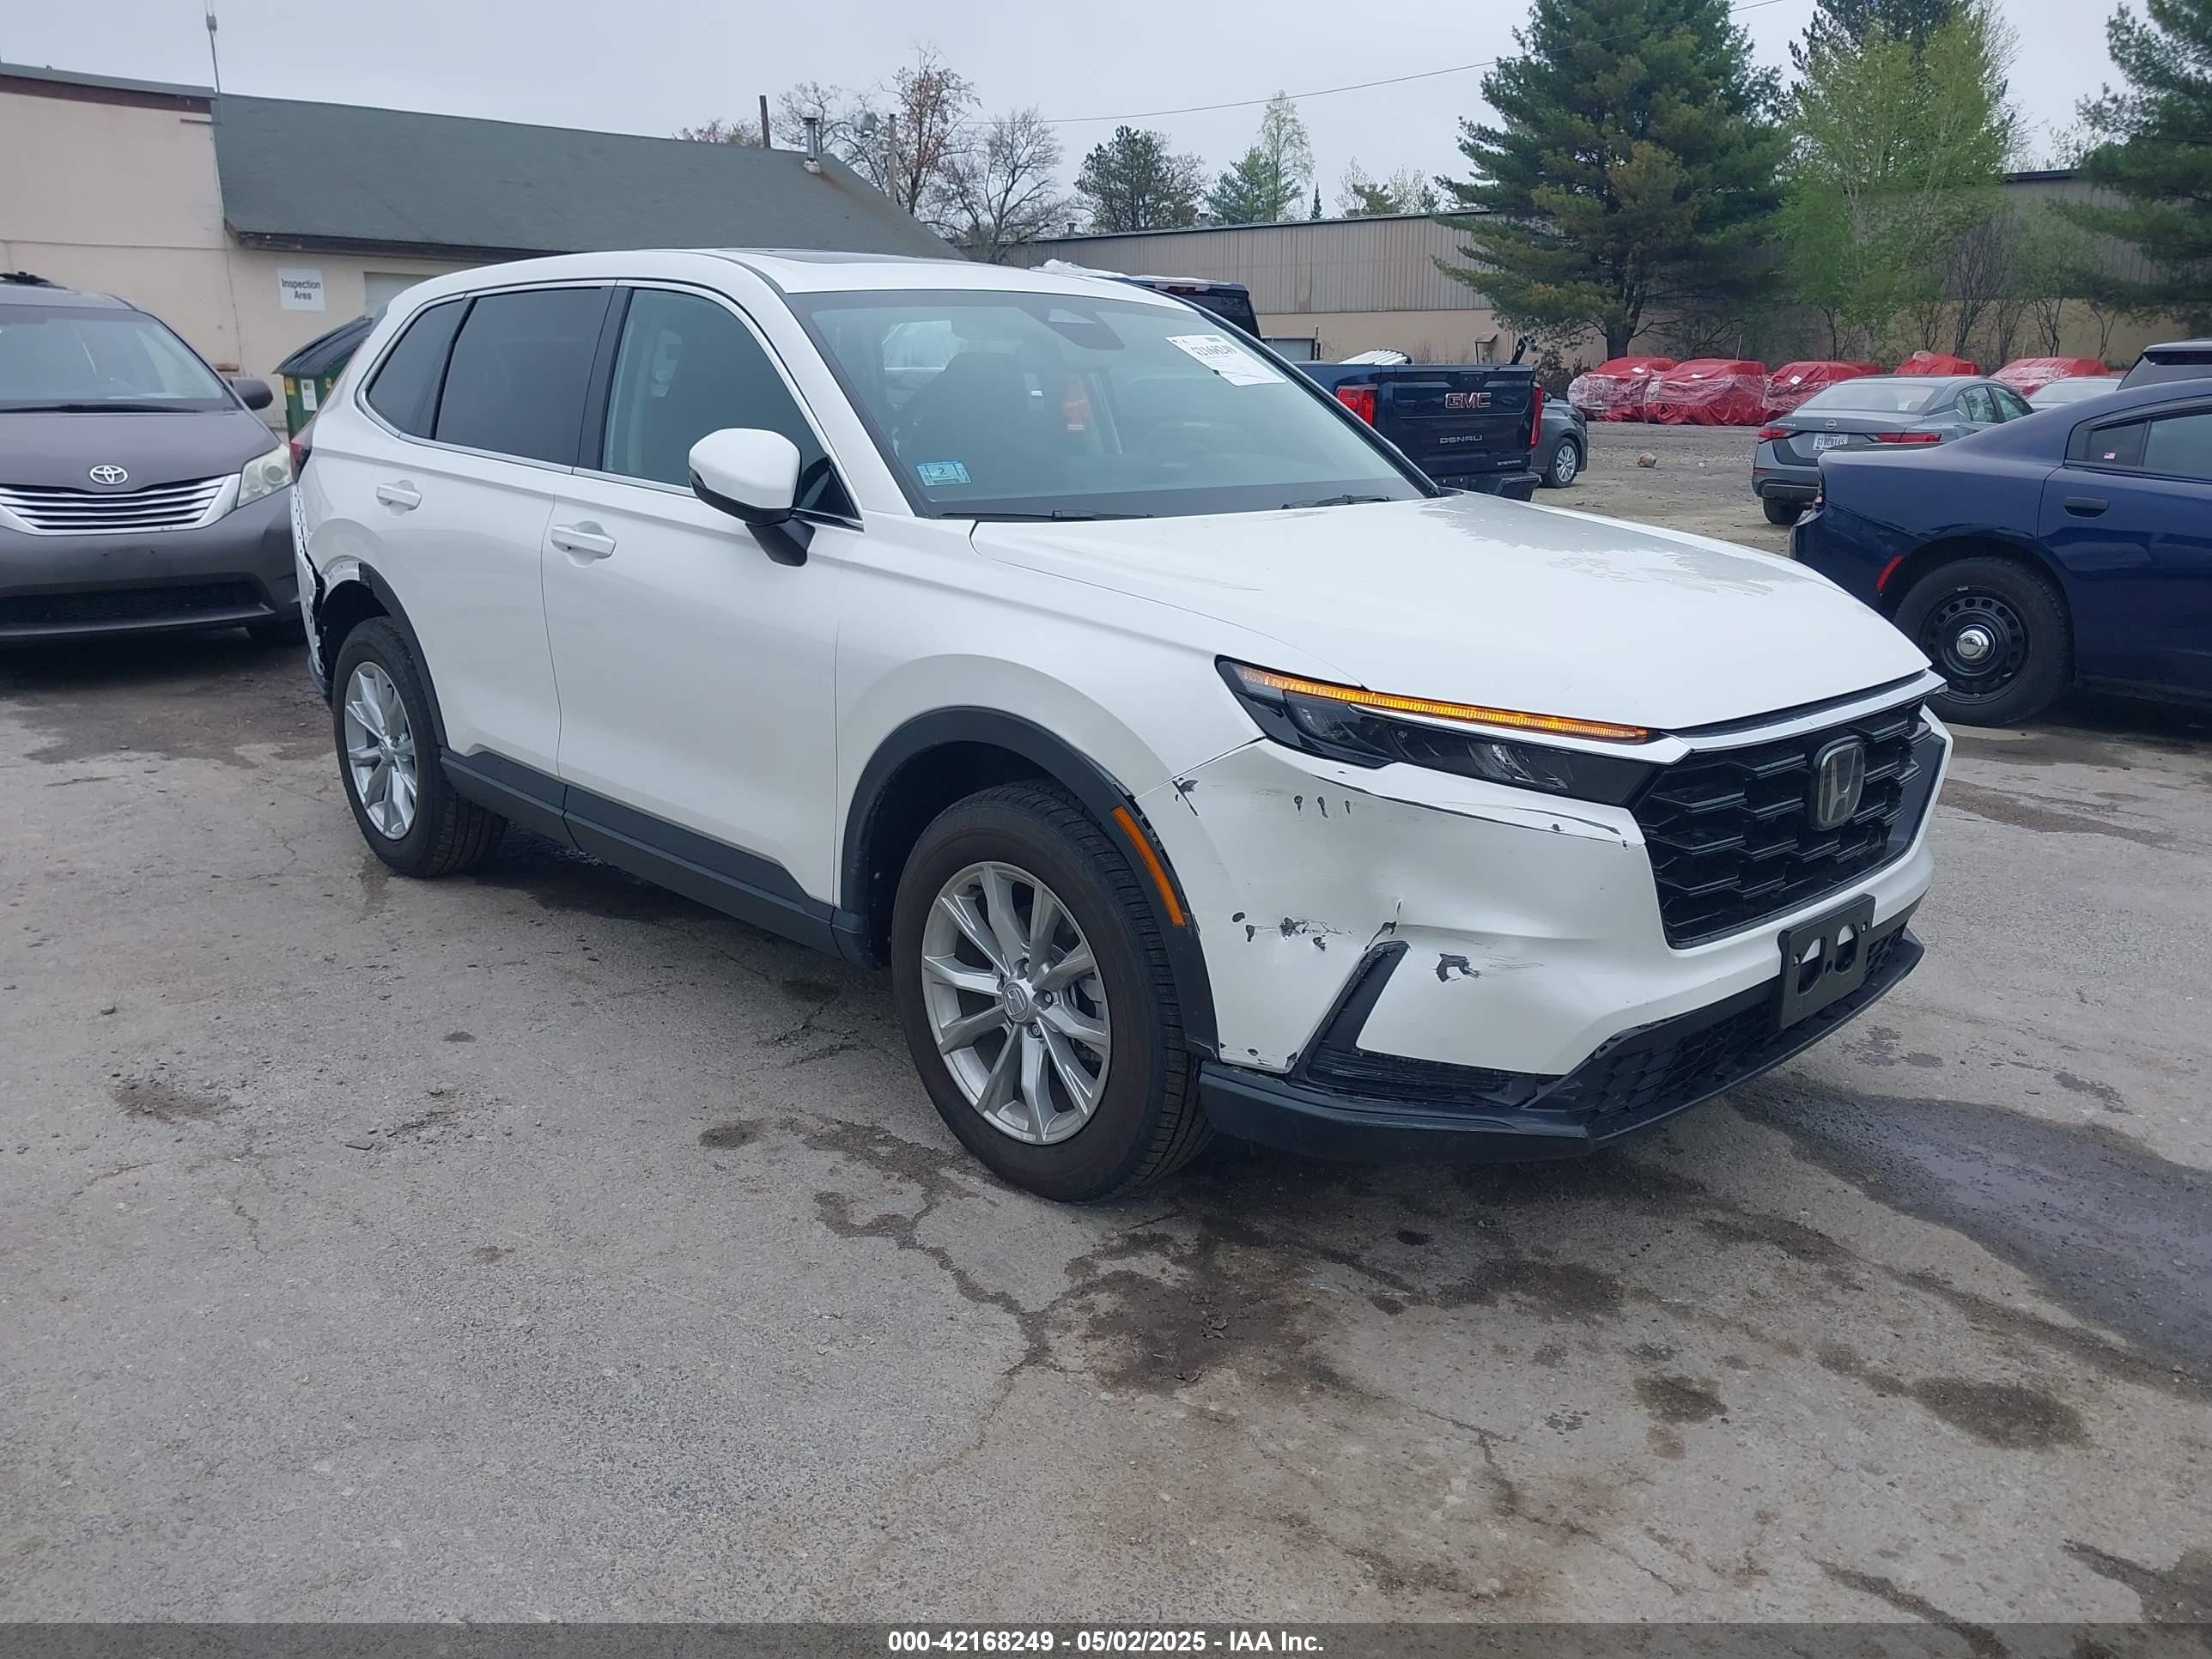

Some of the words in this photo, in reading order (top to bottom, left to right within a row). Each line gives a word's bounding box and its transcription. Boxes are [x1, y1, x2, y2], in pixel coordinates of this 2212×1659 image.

[282, 279, 321, 289] Inspection
[295, 290, 312, 300] Area
[1445, 392, 1492, 409] GMC
